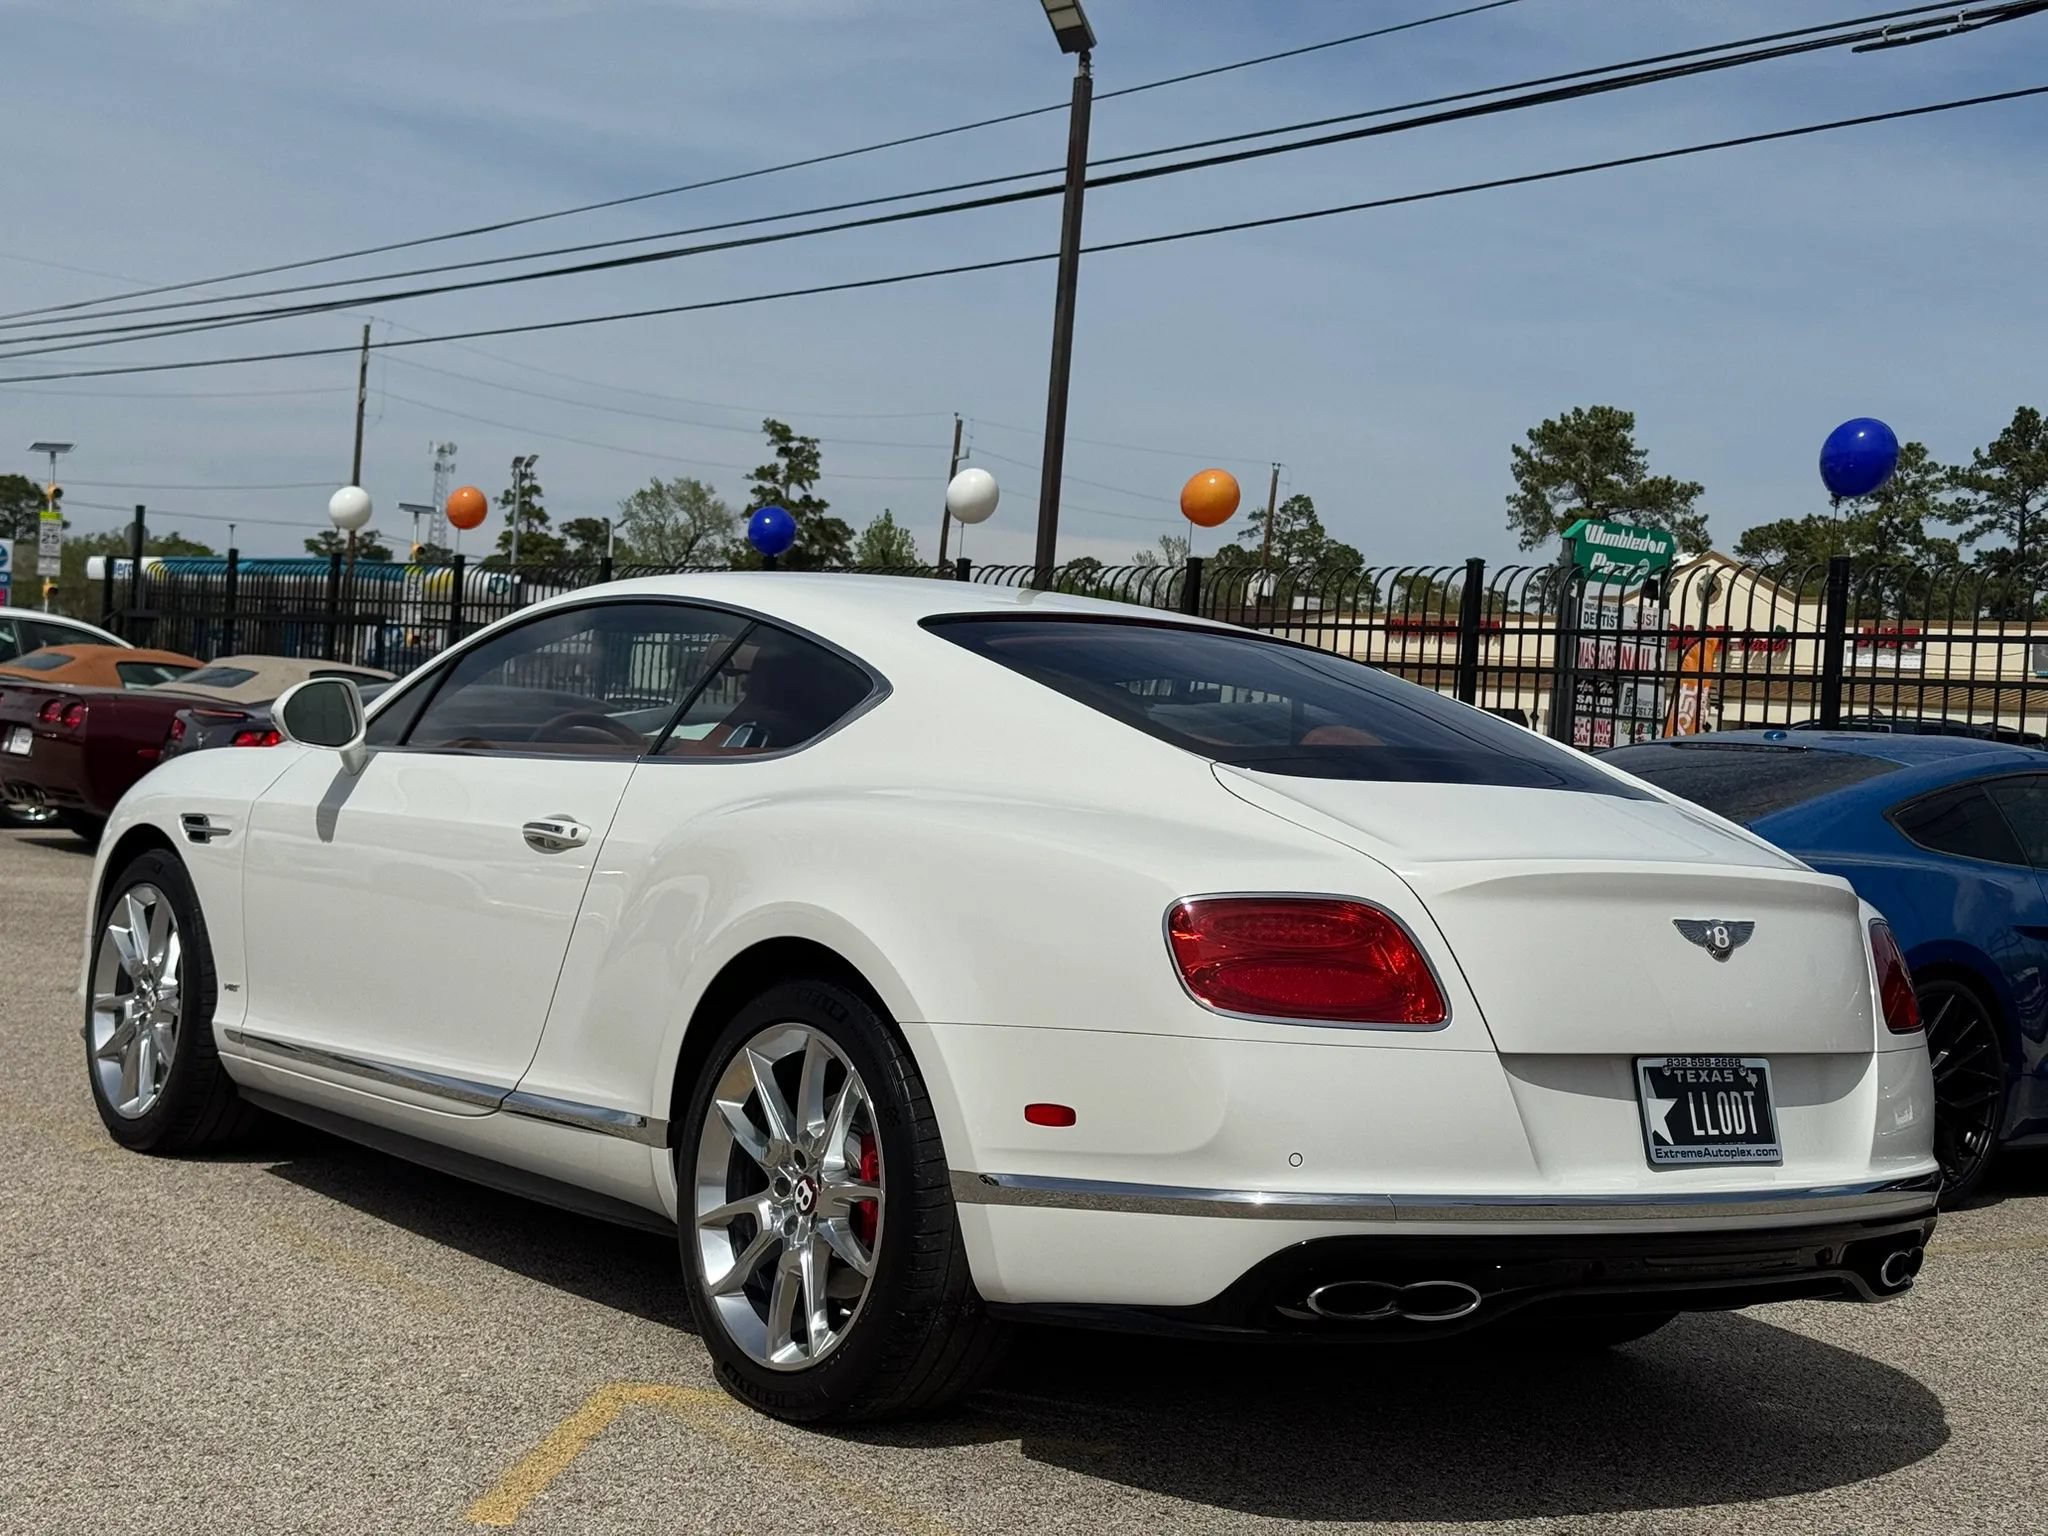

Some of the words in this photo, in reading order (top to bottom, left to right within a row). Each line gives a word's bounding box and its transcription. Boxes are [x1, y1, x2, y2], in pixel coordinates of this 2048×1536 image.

[1585, 523, 1668, 555] Wimbledon
[1590, 552, 1636, 577] Plaza
[1583, 611, 1621, 629] DETIS
[1578, 639, 1619, 670] MASAGE
[1584, 718, 1611, 735] CINIC
[1673, 1070, 1734, 1083] TEXAS
[1655, 1147, 1779, 1159] ExtremeAutoplex.com
